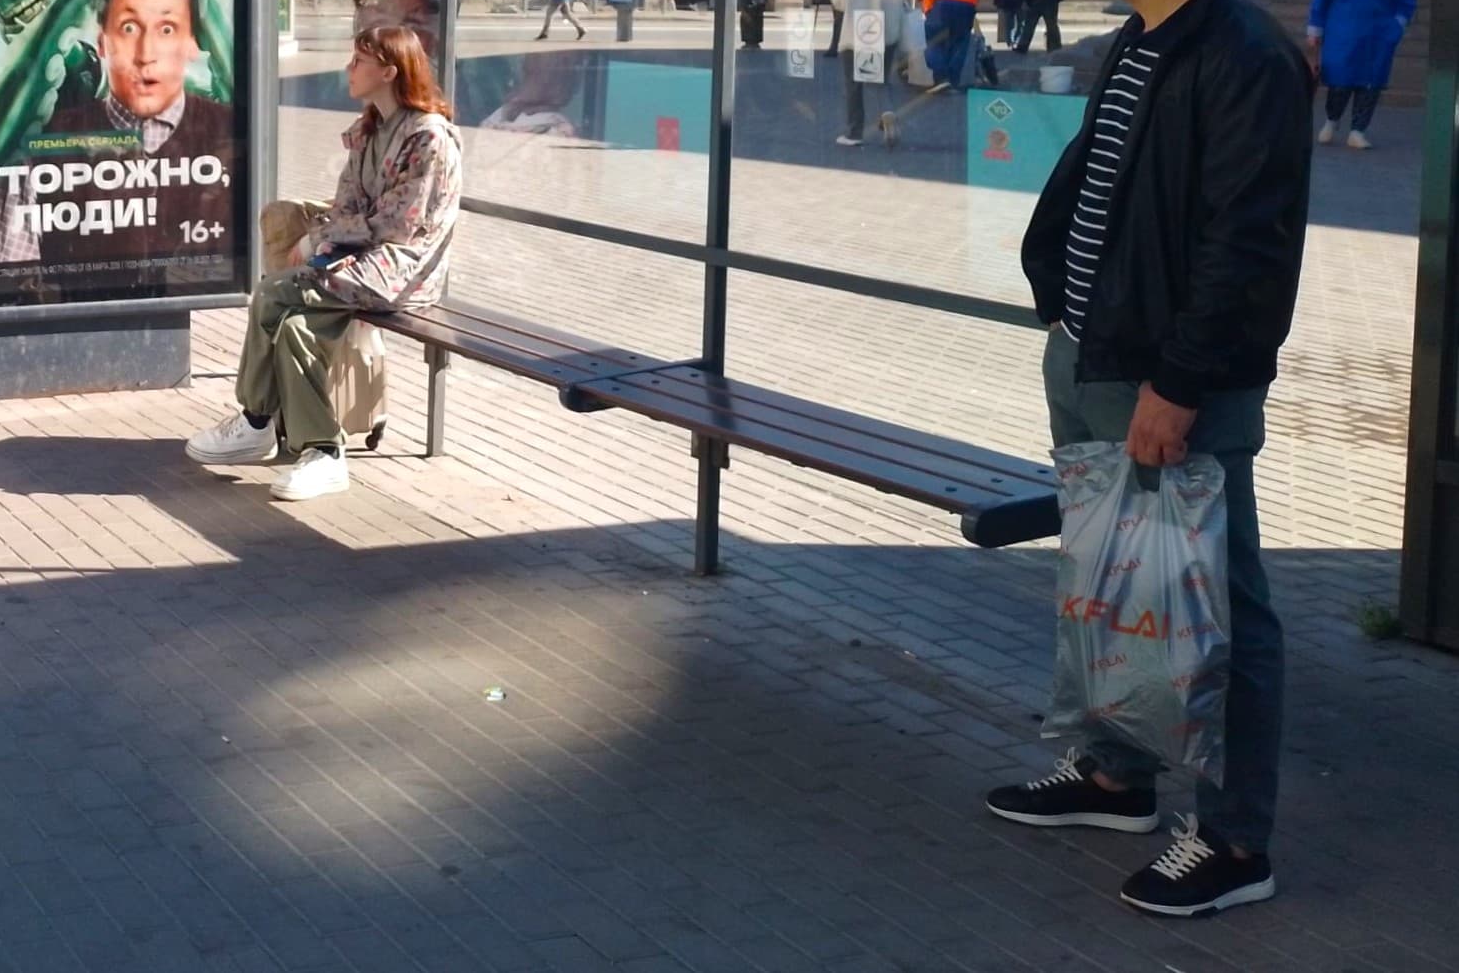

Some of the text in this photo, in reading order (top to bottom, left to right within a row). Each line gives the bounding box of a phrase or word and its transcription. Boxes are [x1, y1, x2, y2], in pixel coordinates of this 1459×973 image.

[28, 138, 86, 150] ПРЕМЬЕРА
[11, 197, 158, 235] ЛЮДИ!
[178, 219, 225, 244] 16+
